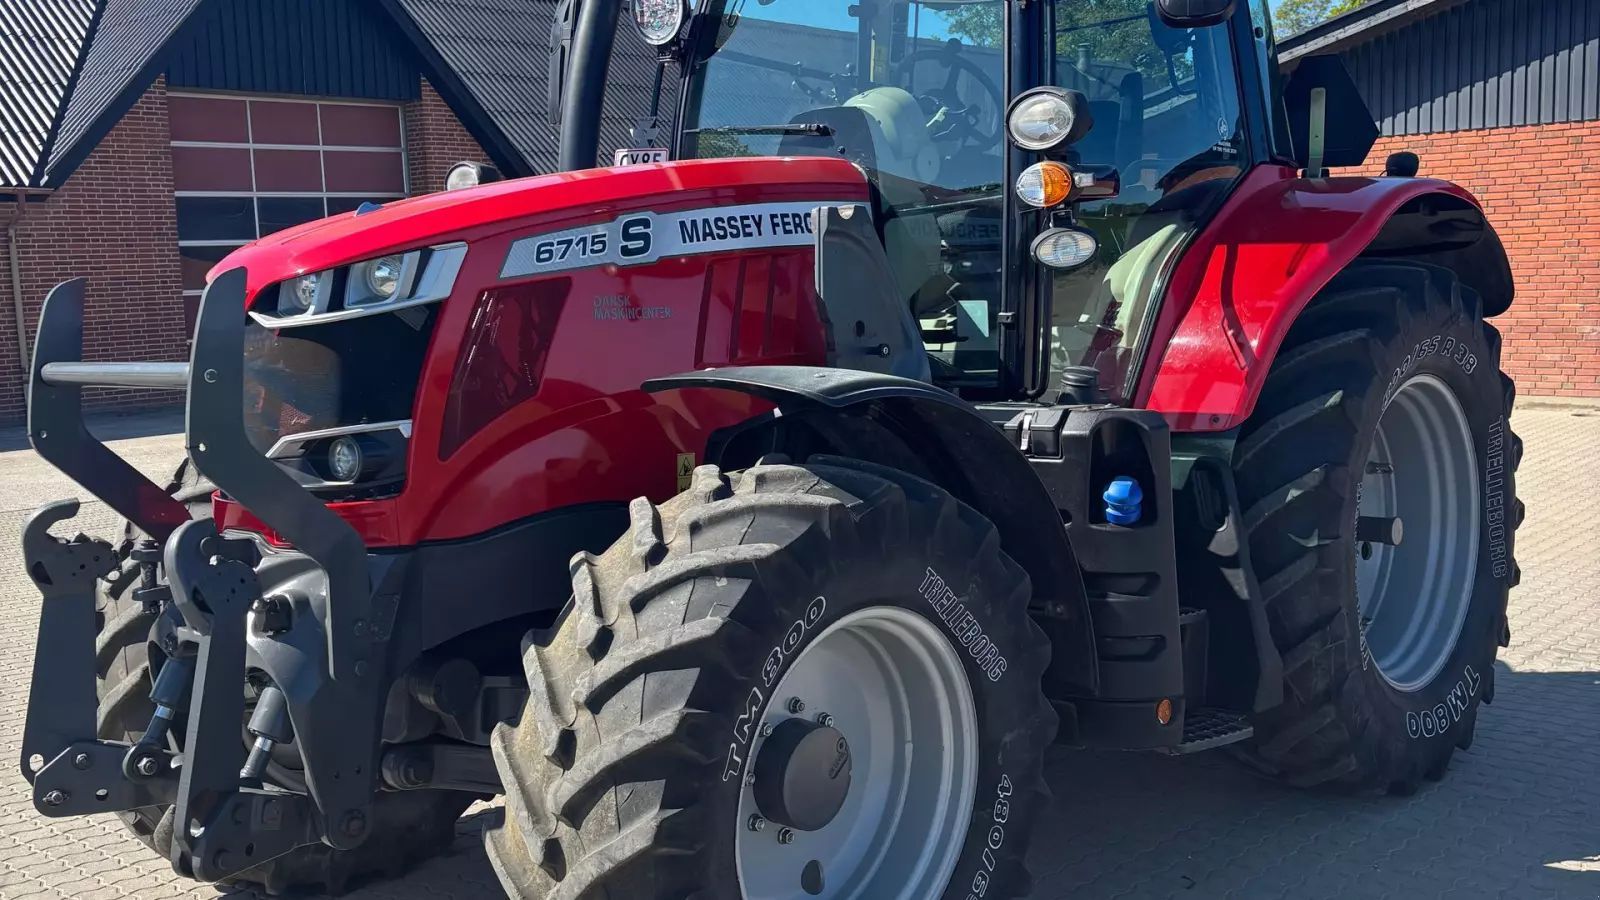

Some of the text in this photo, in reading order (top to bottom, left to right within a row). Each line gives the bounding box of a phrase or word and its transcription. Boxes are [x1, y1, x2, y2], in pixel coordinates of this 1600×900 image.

[534, 231, 608, 264] 6715
[619, 216, 653, 259] S
[678, 212, 764, 245] MASSEY
[1440, 336, 1456, 357] R
[1453, 343, 1478, 375] 38
[1485, 414, 1508, 579] TRELLEBORG
[918, 566, 1009, 683] TRELLEBORG
